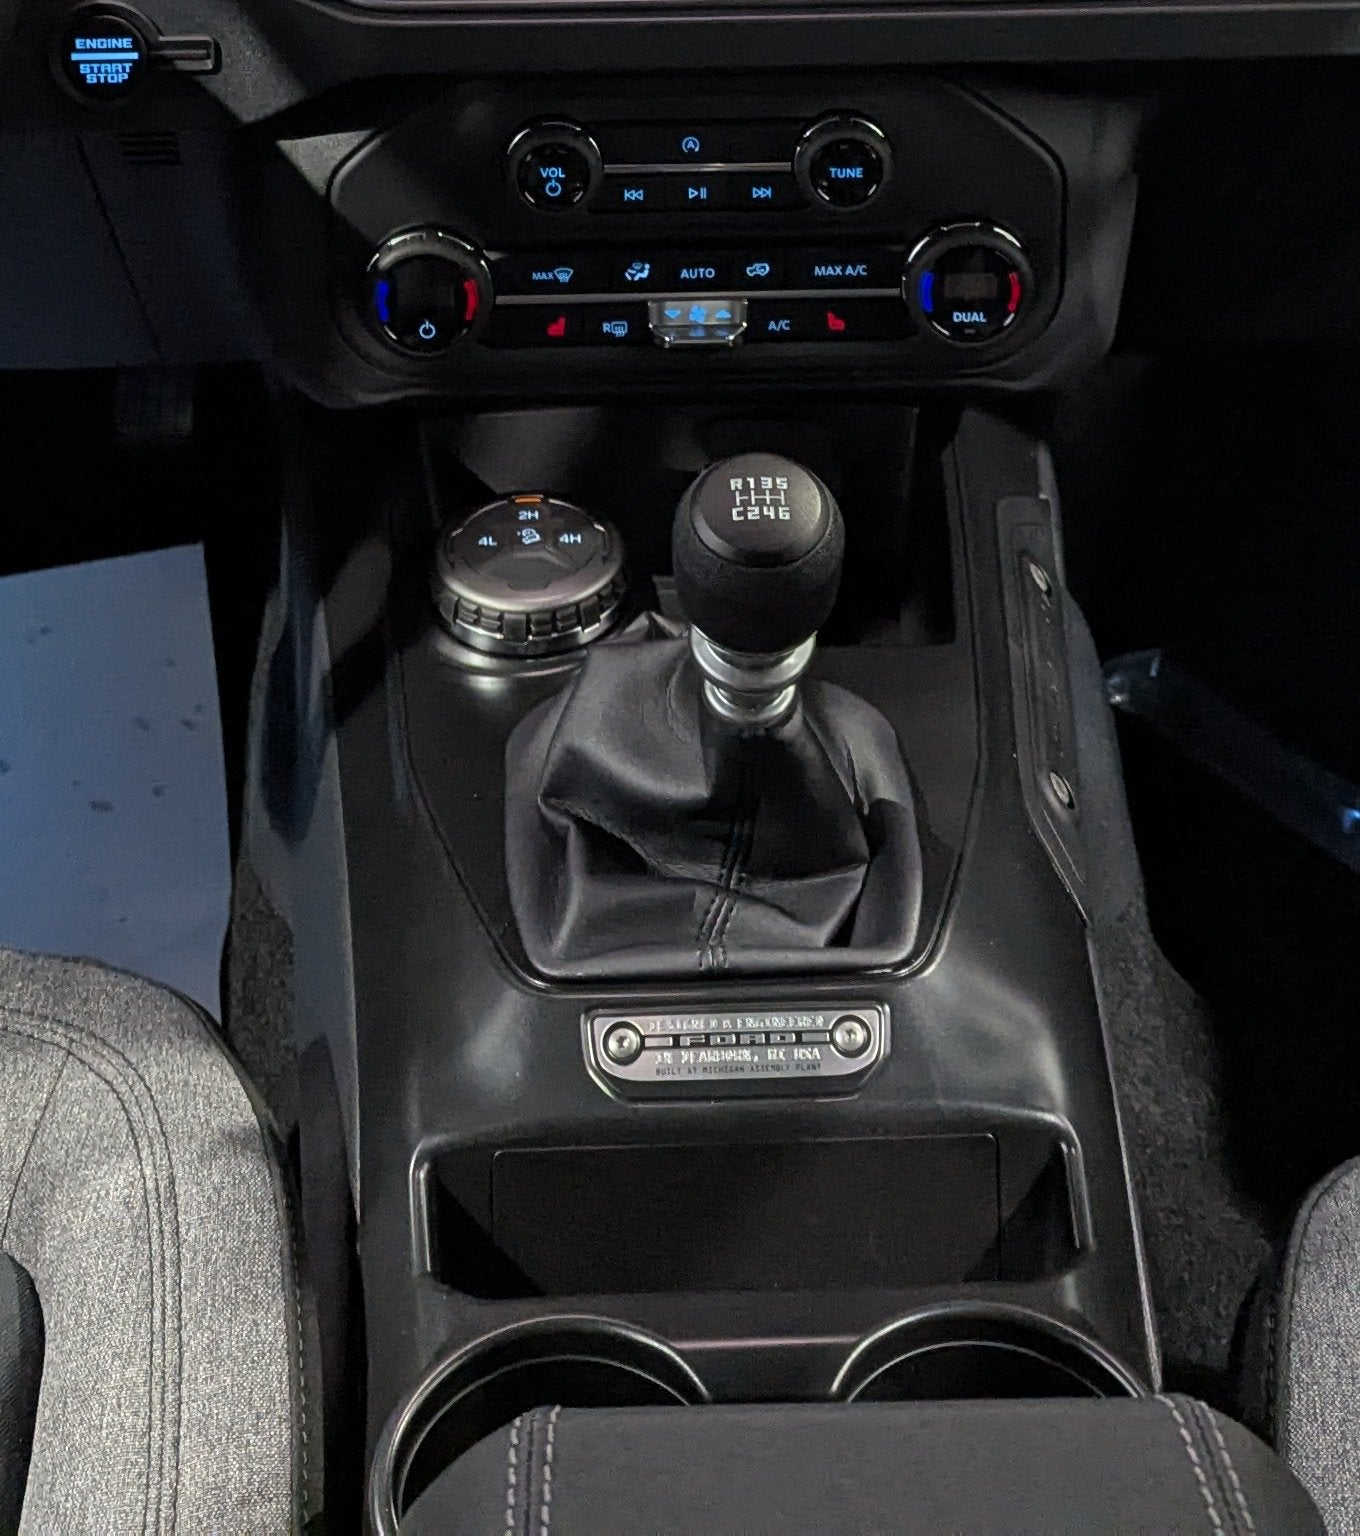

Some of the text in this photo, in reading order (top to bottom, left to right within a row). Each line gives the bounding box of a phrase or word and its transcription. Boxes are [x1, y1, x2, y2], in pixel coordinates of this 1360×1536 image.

[75, 38, 133, 49] ENGINE
[79, 63, 133, 74] START
[86, 73, 129, 84] STOP
[540, 167, 566, 179] VOL
[829, 167, 864, 179] TUNE
[531, 271, 555, 281] MAX
[680, 267, 716, 279] AUTO
[814, 264, 868, 277] MAX A/C
[952, 311, 988, 324] DUAL
[602, 322, 612, 333] R
[767, 319, 791, 332] A/C
[518, 510, 539, 521] 2H
[478, 535, 498, 546] 4L
[559, 532, 582, 544] 4H
